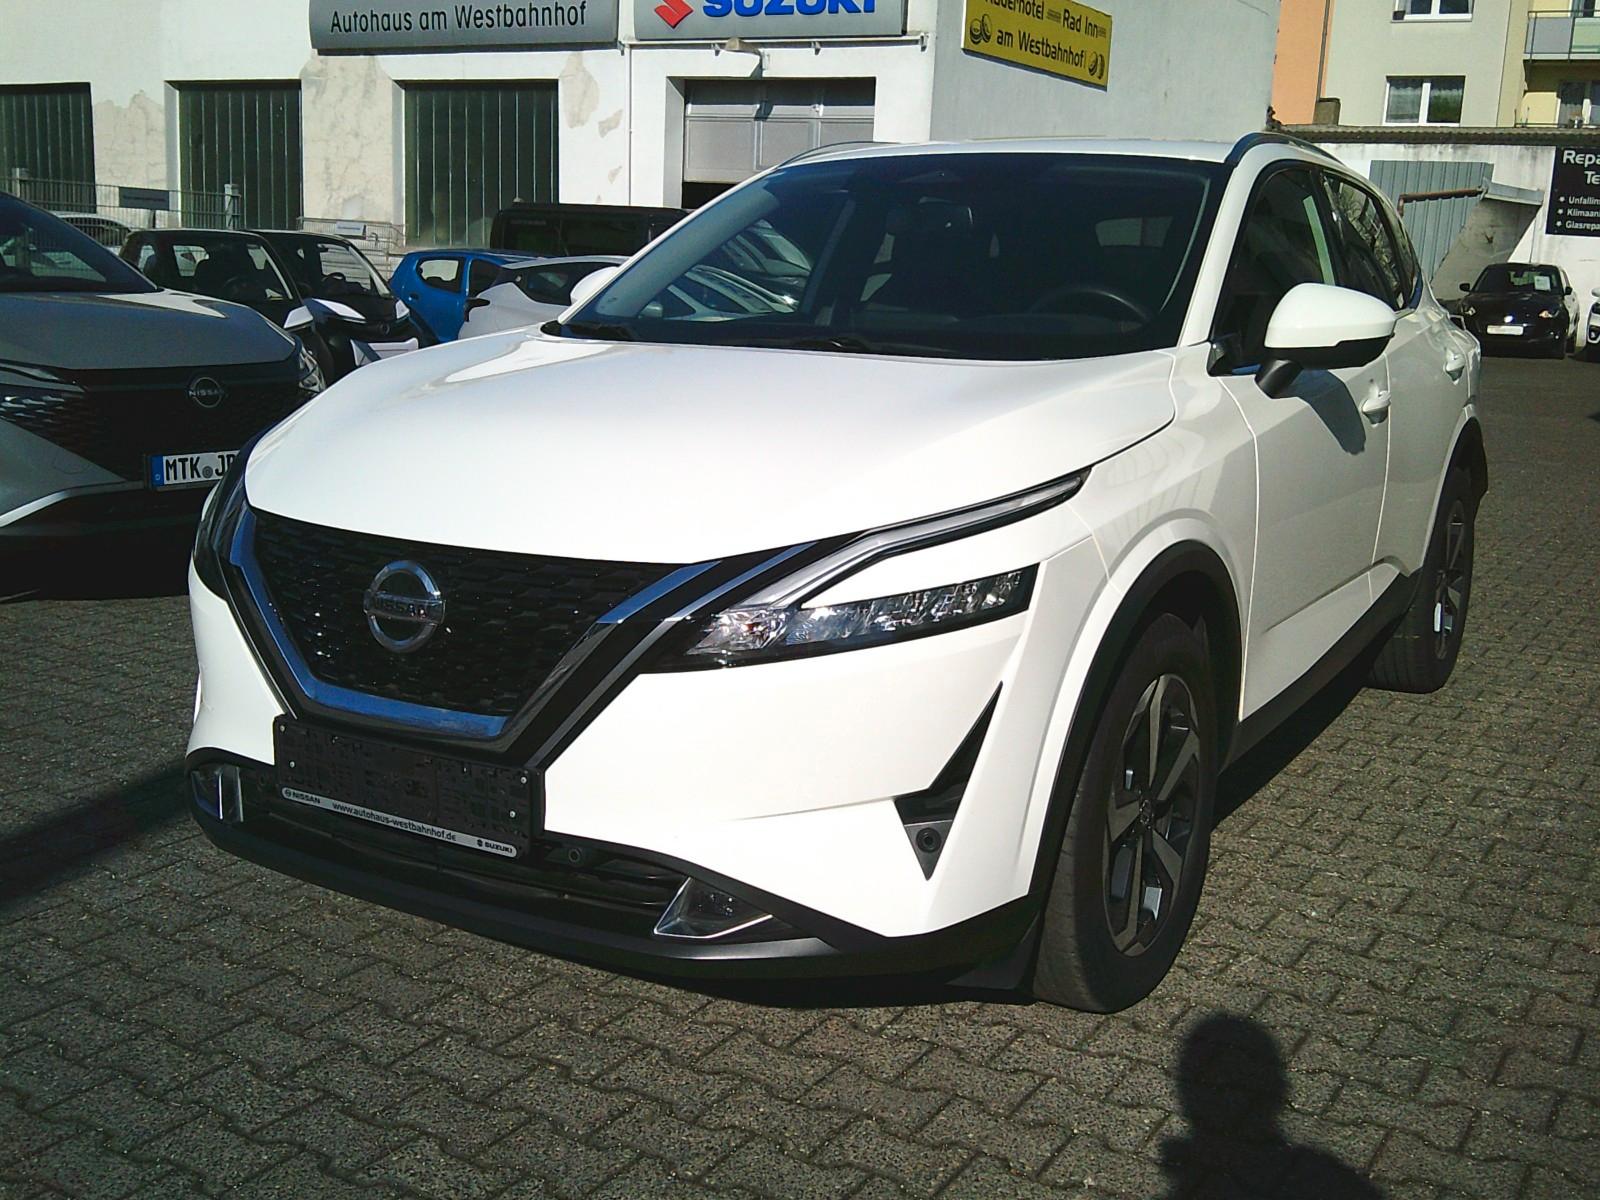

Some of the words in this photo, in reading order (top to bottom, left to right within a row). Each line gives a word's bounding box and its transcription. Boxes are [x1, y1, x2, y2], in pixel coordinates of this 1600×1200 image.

[331, 10, 412, 33] Autohaus
[419, 11, 447, 31] am
[455, 1, 586, 29] Westbahnhof
[703, 0, 876, 17] SUZUKI
[985, 0, 1045, 20] erhotel
[1063, 9, 1082, 32] Rad
[1085, 16, 1098, 38] Inn
[997, 29, 1013, 48] am
[1018, 30, 1084, 67] Westbahnhof
[1584, 170, 1600, 185] Te
[165, 456, 201, 480] MTK
[292, 791, 320, 804] NISSAN
[332, 802, 456, 842] www.autohaus-westbahnhof.de
[485, 841, 513, 853] SUZUKI
